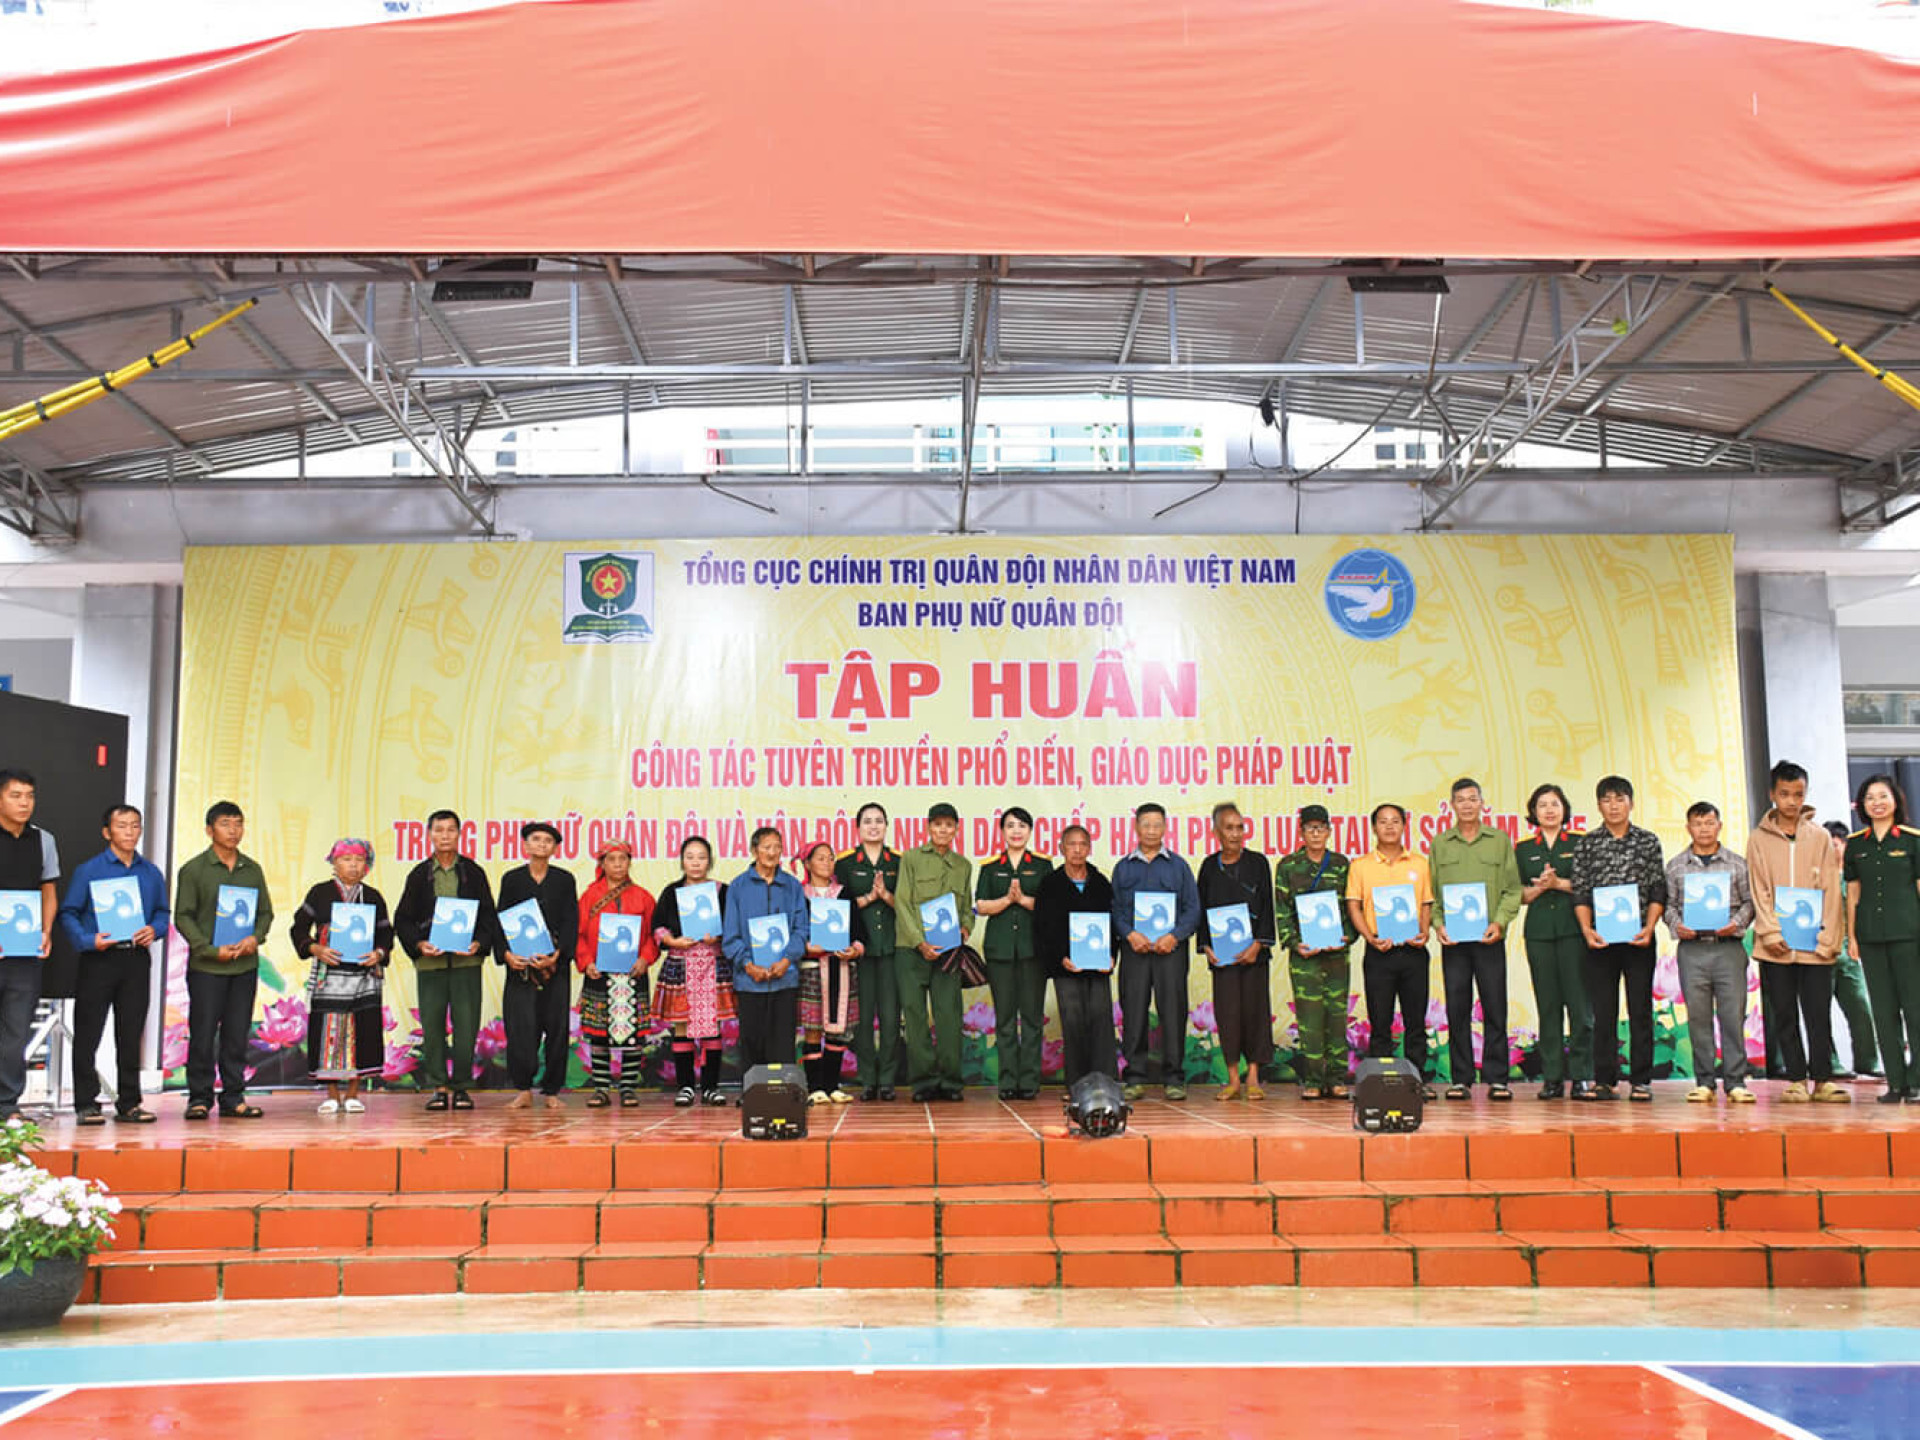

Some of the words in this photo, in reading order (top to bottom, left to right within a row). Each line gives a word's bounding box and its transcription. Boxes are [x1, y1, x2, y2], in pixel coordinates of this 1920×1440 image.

[684, 551, 746, 586] TỔNG
[754, 560, 801, 590] CỤC
[809, 554, 882, 585] CHÍNH
[889, 559, 926, 590] TRỊ
[934, 554, 998, 585] QUÂN
[1006, 554, 1045, 590] ĐỘI
[1054, 554, 1120, 585] NHÂN
[1128, 554, 1176, 585] DÂN
[1184, 554, 1231, 589] VIỆT
[1241, 559, 1296, 584] NAM
[858, 602, 907, 627] BAN
[915, 602, 962, 632] PHỤ
[971, 598, 1006, 627] NỮ
[1011, 597, 1077, 627] QUÂN
[1083, 597, 1123, 632] ĐỘI
[785, 650, 941, 732] TẬP
[972, 641, 1197, 719] HUẤN
[631, 740, 700, 788] CÔNG
[708, 739, 757, 788] TÁC
[764, 739, 844, 787] TUYÊN
[851, 733, 949, 787] TRUYỀN
[957, 730, 1008, 786] PHỔ
[1016, 733, 1083, 791] BIẾN,
[1091, 738, 1150, 786] GIÁO
[1158, 746, 1208, 795] DỤC
[1217, 738, 1283, 786] PHÁP
[1292, 738, 1352, 794] LUẬT
[394, 820, 477, 861] TRG
[716, 809, 749, 859] VÀ
[894, 817, 964, 857] NHN
[973, 808, 1005, 857] DÂ
[1187, 817, 1254, 857] PHP
